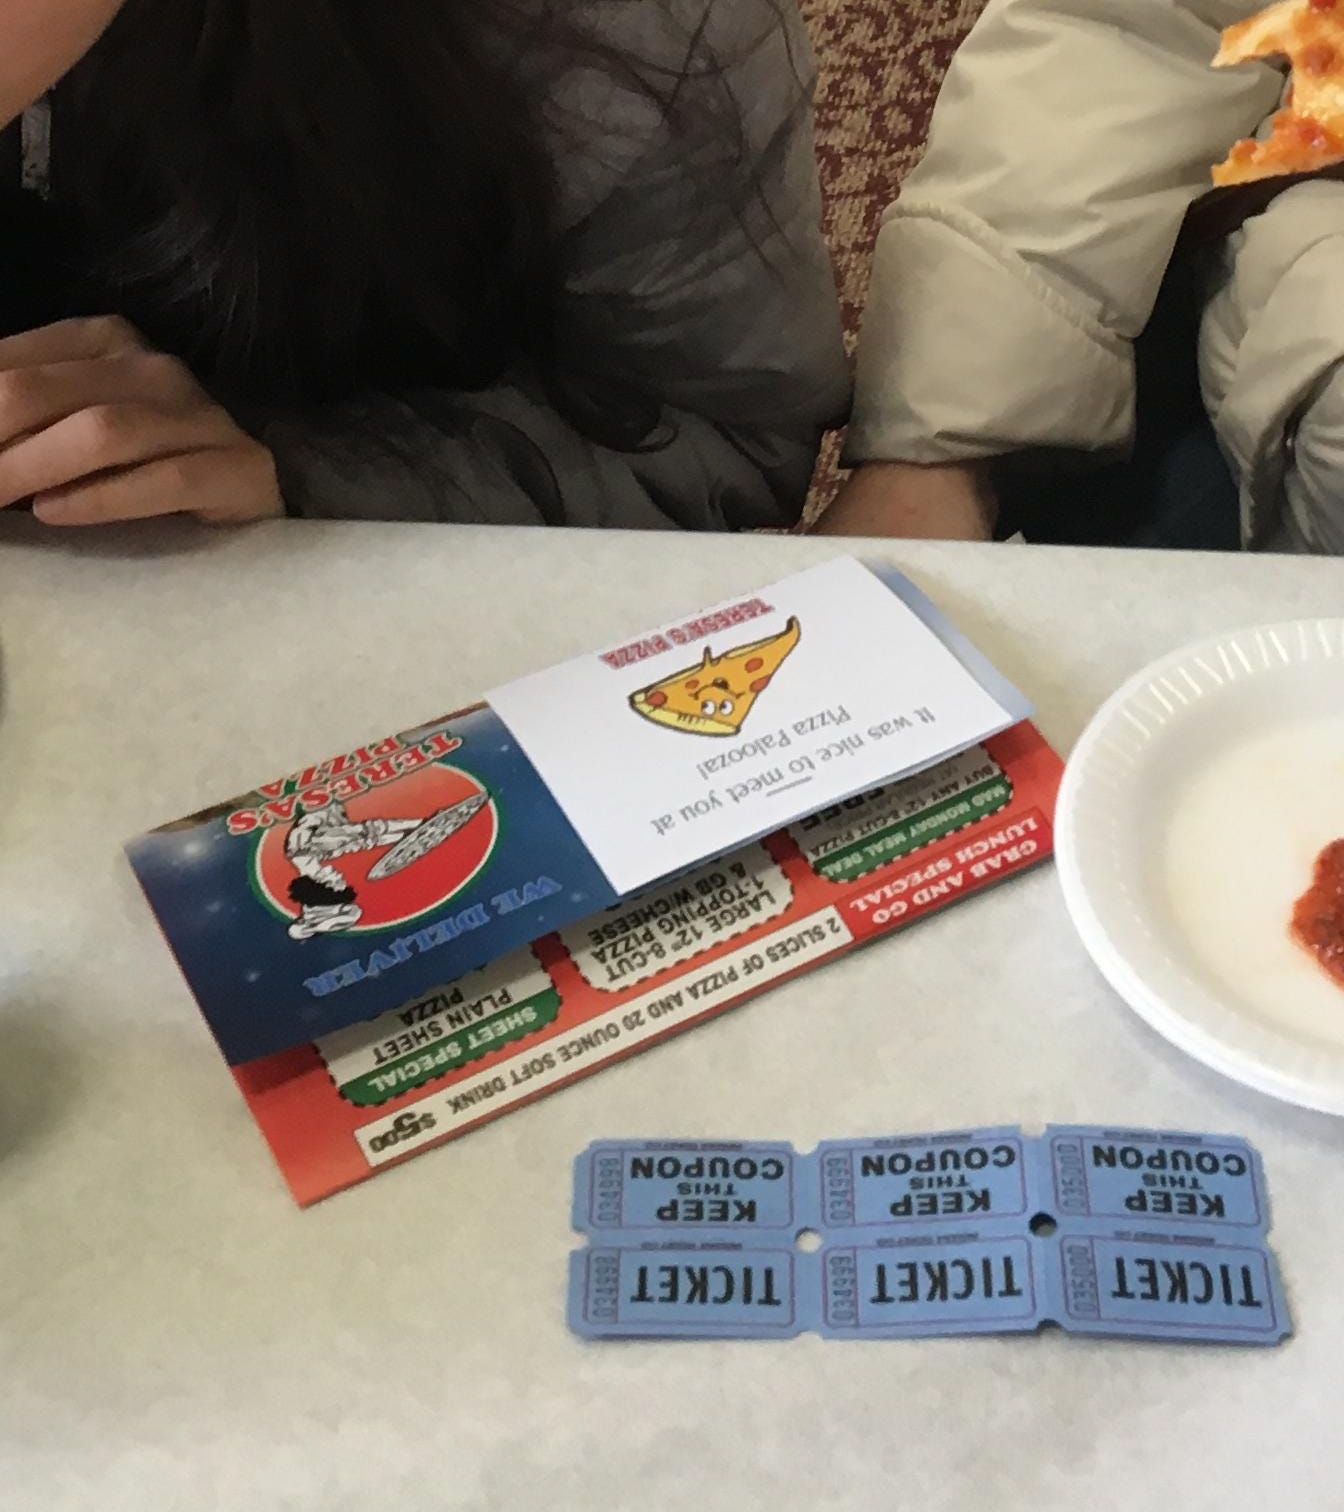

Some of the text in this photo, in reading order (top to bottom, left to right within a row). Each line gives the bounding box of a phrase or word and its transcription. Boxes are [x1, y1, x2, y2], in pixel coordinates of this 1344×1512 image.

[597, 595, 774, 669] TERESA'S PIZZA
[694, 702, 851, 781] Pizza Palooza!
[225, 730, 462, 836] TERESA'S
[255, 734, 402, 799] PIZZA
[649, 705, 935, 838] It was nice to meet you at
[964, 763, 994, 786] BUY
[929, 779, 960, 802] ANY
[808, 829, 853, 858] PIZZA
[819, 783, 1005, 879] MAD MONDAY MEAL DEAL
[728, 860, 747, 881] &
[847, 816, 1037, 914] LUNCH SPECIAL
[870, 836, 1038, 925] GRAB AND GO
[590, 872, 765, 966] 1-TOPPING PIZZA
[705, 888, 776, 934] LARGE
[825, 916, 841, 935] 2
[302, 870, 561, 1000] WE DELIVER
[764, 923, 825, 963] SLICES
[602, 941, 666, 982] 8-CUT
[739, 952, 765, 976] OF
[685, 965, 738, 1002] PIZZA
[396, 986, 464, 1029] PIZZA
[620, 1009, 645, 1032] 20
[645, 990, 685, 1020] AND
[369, 986, 513, 1065] PLAIN SHEET
[555, 1020, 621, 1065] OUNCE
[366, 1003, 538, 1095] SHEET SPECIAL
[508, 1051, 557, 1087] SOFT
[446, 1074, 507, 1115] DRINK
[631, 1157, 783, 1179] COUPON
[861, 1145, 1015, 1176] COUPON
[1092, 1145, 1246, 1175] COUPON
[676, 1182, 736, 1195] THIS
[909, 1173, 967, 1189] THIS
[1141, 1173, 1201, 1189] THIS
[656, 1199, 756, 1221] KEEP
[890, 1187, 990, 1216] KEEP
[1124, 1189, 1224, 1217] KEEP
[630, 1266, 781, 1306] TICKET
[869, 1256, 1022, 1303] TICKET
[1111, 1257, 1261, 1308] TICKET
